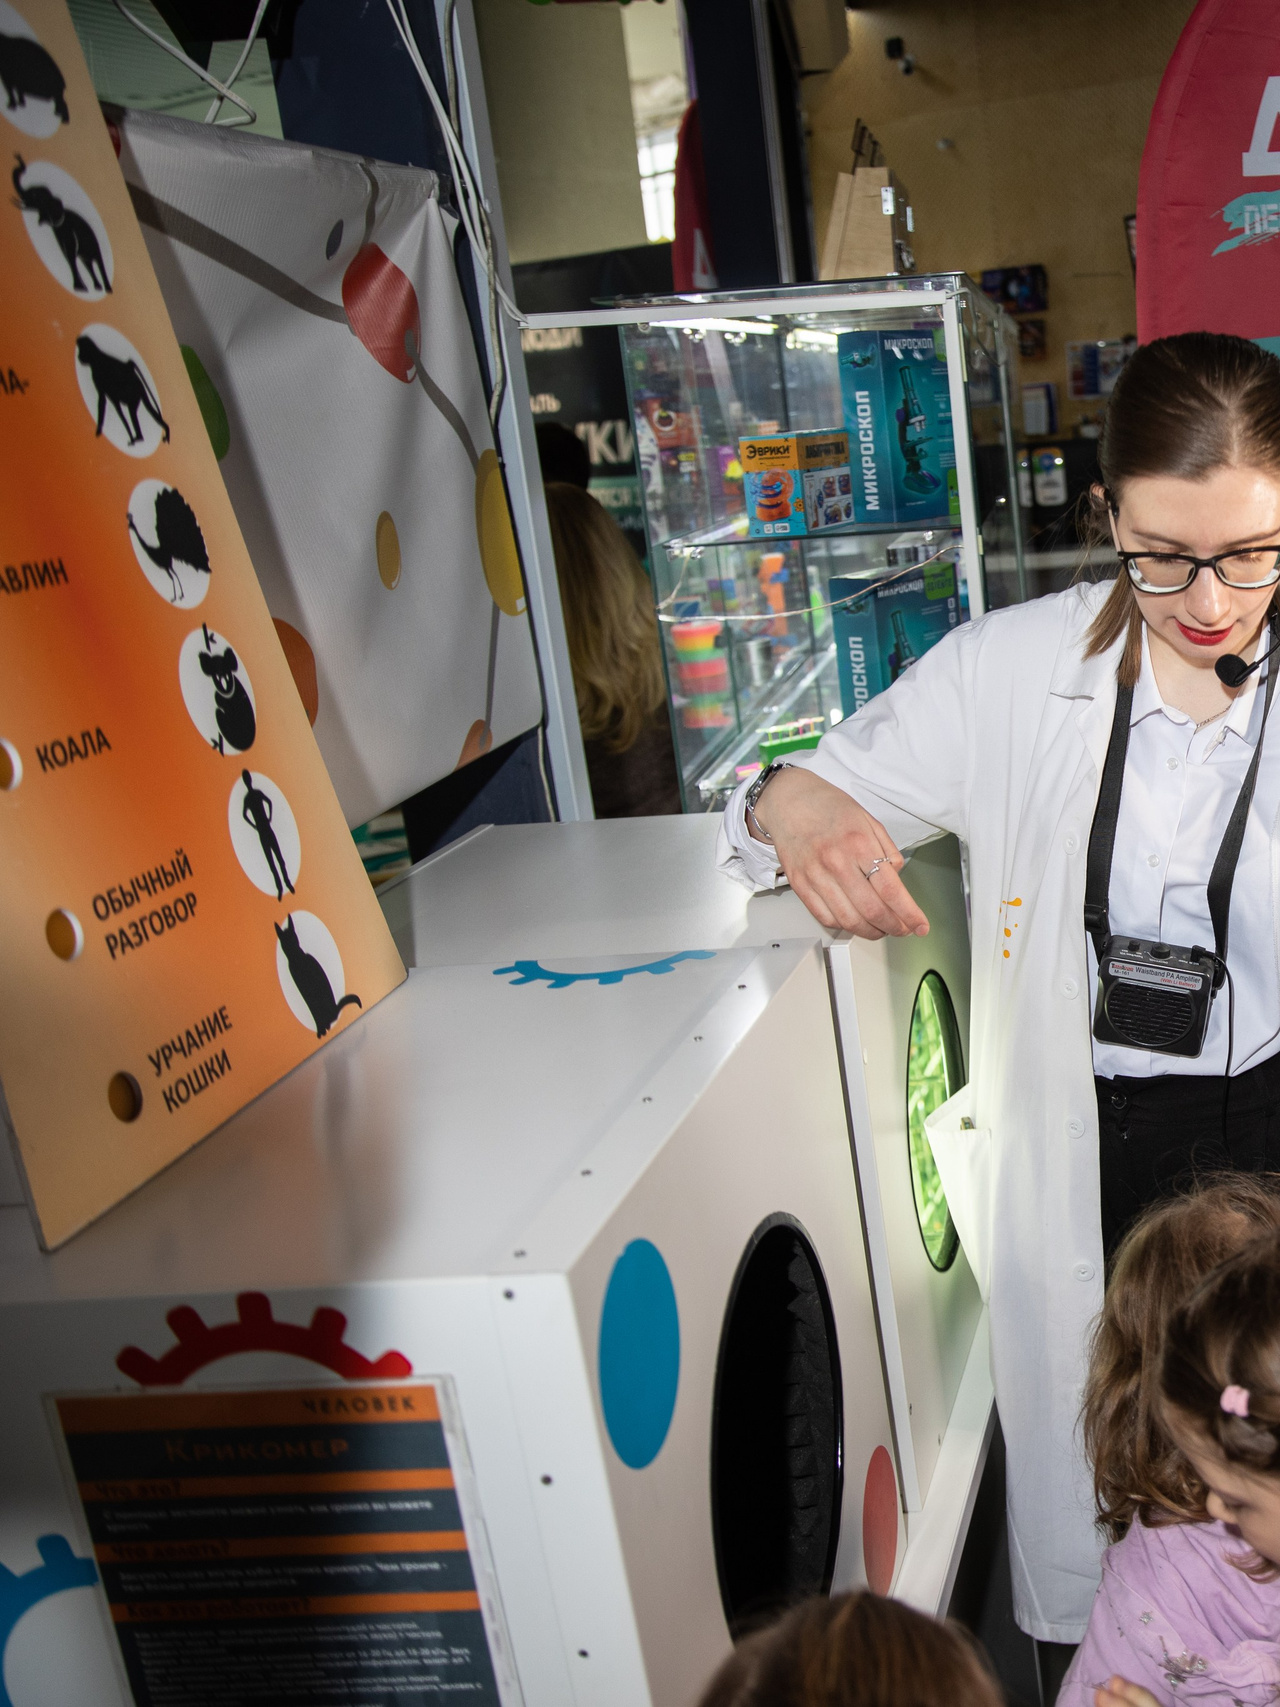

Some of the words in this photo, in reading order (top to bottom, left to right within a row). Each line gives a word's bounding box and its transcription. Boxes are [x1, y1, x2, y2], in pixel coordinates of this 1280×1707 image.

[884, 337, 934, 351] МИКРОСКОП
[855, 390, 880, 512] МИКРОСКОП
[36, 726, 113, 774] КОАЛА
[91, 847, 195, 922] ОБЫЧНЫЙ
[105, 891, 199, 960] РАЗГОВОР
[1135, 966, 1166, 978] Waistband
[1166, 971, 1175, 979] PA
[1176, 974, 1201, 984] Amplifier
[147, 1005, 234, 1077] УРЧАНИЕ
[162, 1048, 233, 1113] КОШКИ
[302, 1394, 417, 1416] ЧЕЛОВЕК
